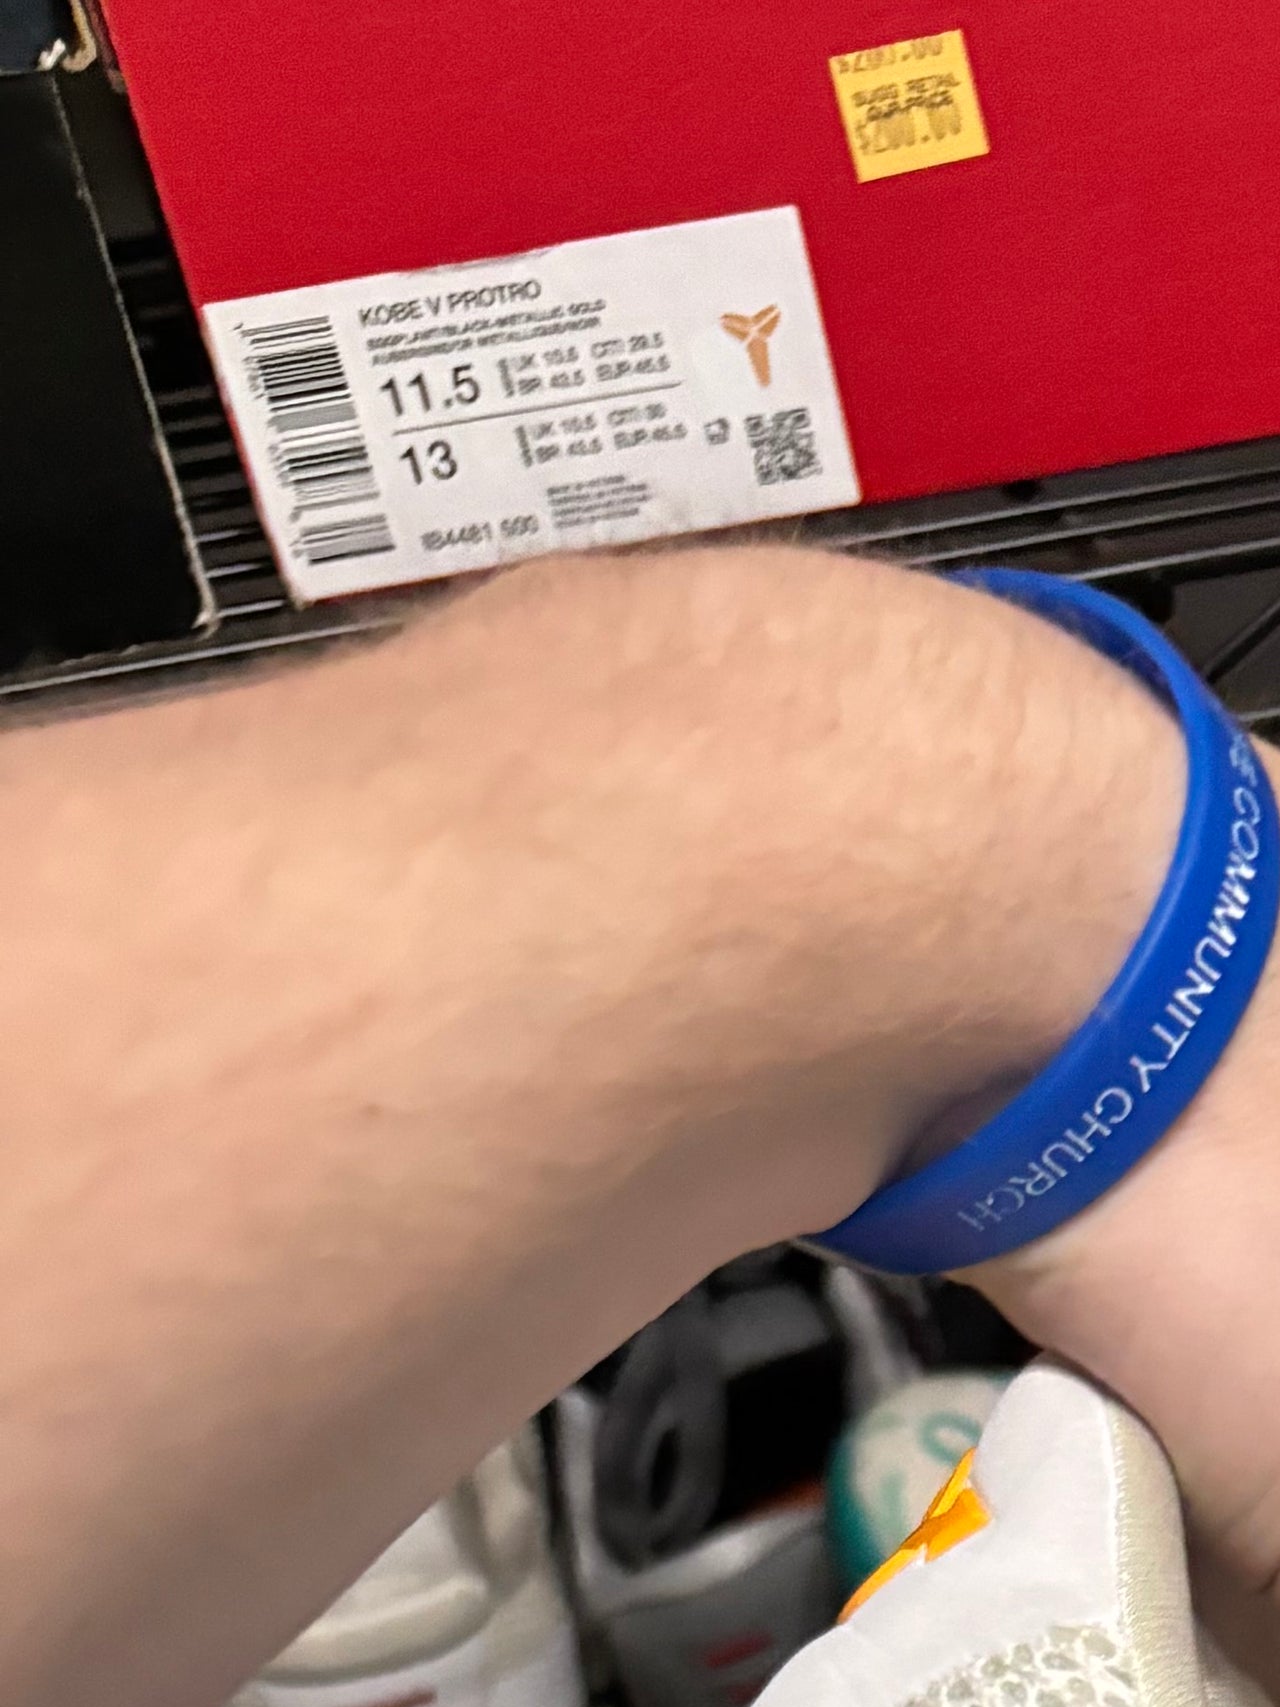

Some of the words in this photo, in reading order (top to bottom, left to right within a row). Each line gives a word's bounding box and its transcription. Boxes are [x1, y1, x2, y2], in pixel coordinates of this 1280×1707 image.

[358, 299, 424, 328] KOBE
[426, 296, 442, 316] V
[447, 279, 542, 314] PROTRO
[379, 364, 482, 418] 11.5
[399, 439, 459, 488] 13
[1130, 787, 1265, 1094] COMMUNITY
[955, 1085, 1135, 1233] CHURCH
